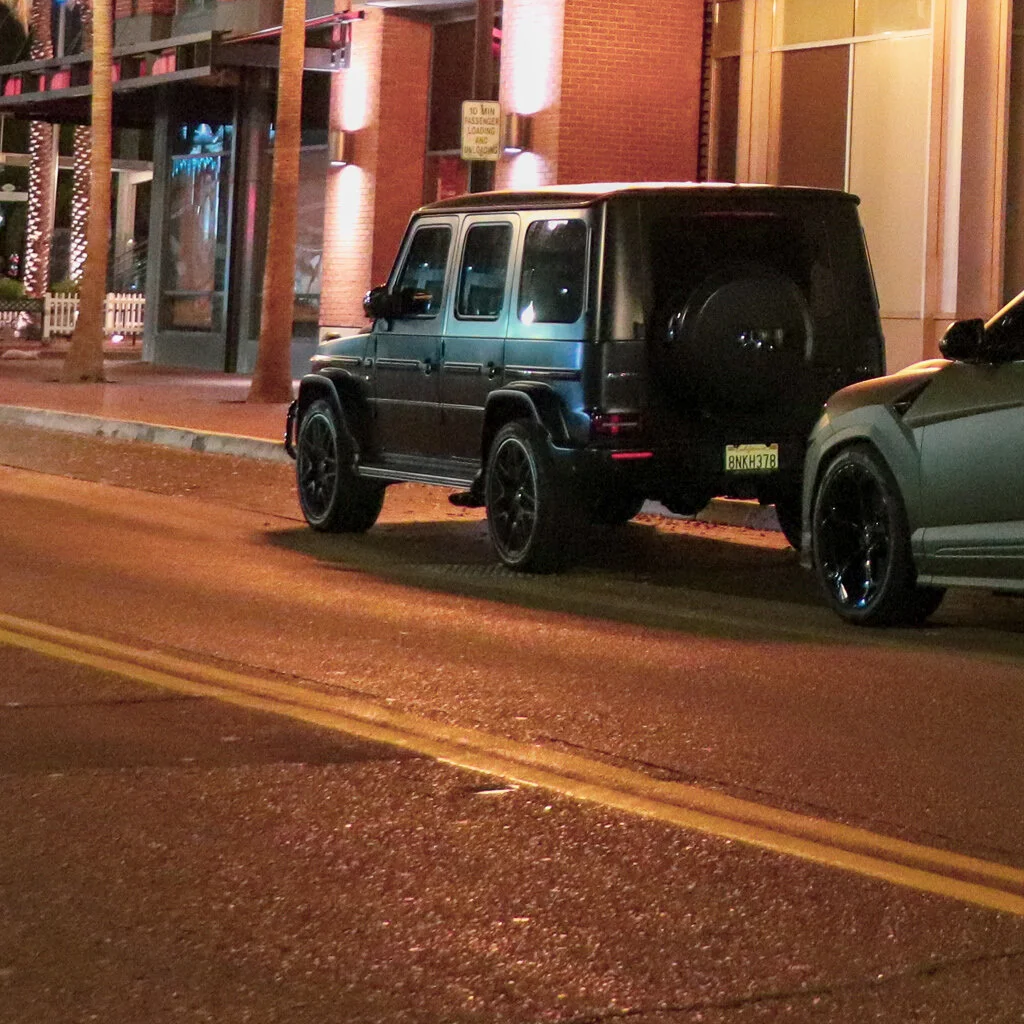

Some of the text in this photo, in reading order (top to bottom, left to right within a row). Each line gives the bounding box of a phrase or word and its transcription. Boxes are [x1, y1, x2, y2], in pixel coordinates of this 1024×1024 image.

[480, 106, 496, 115] MIN
[467, 127, 496, 135] LOADING
[728, 454, 776, 470] 8NKH378
